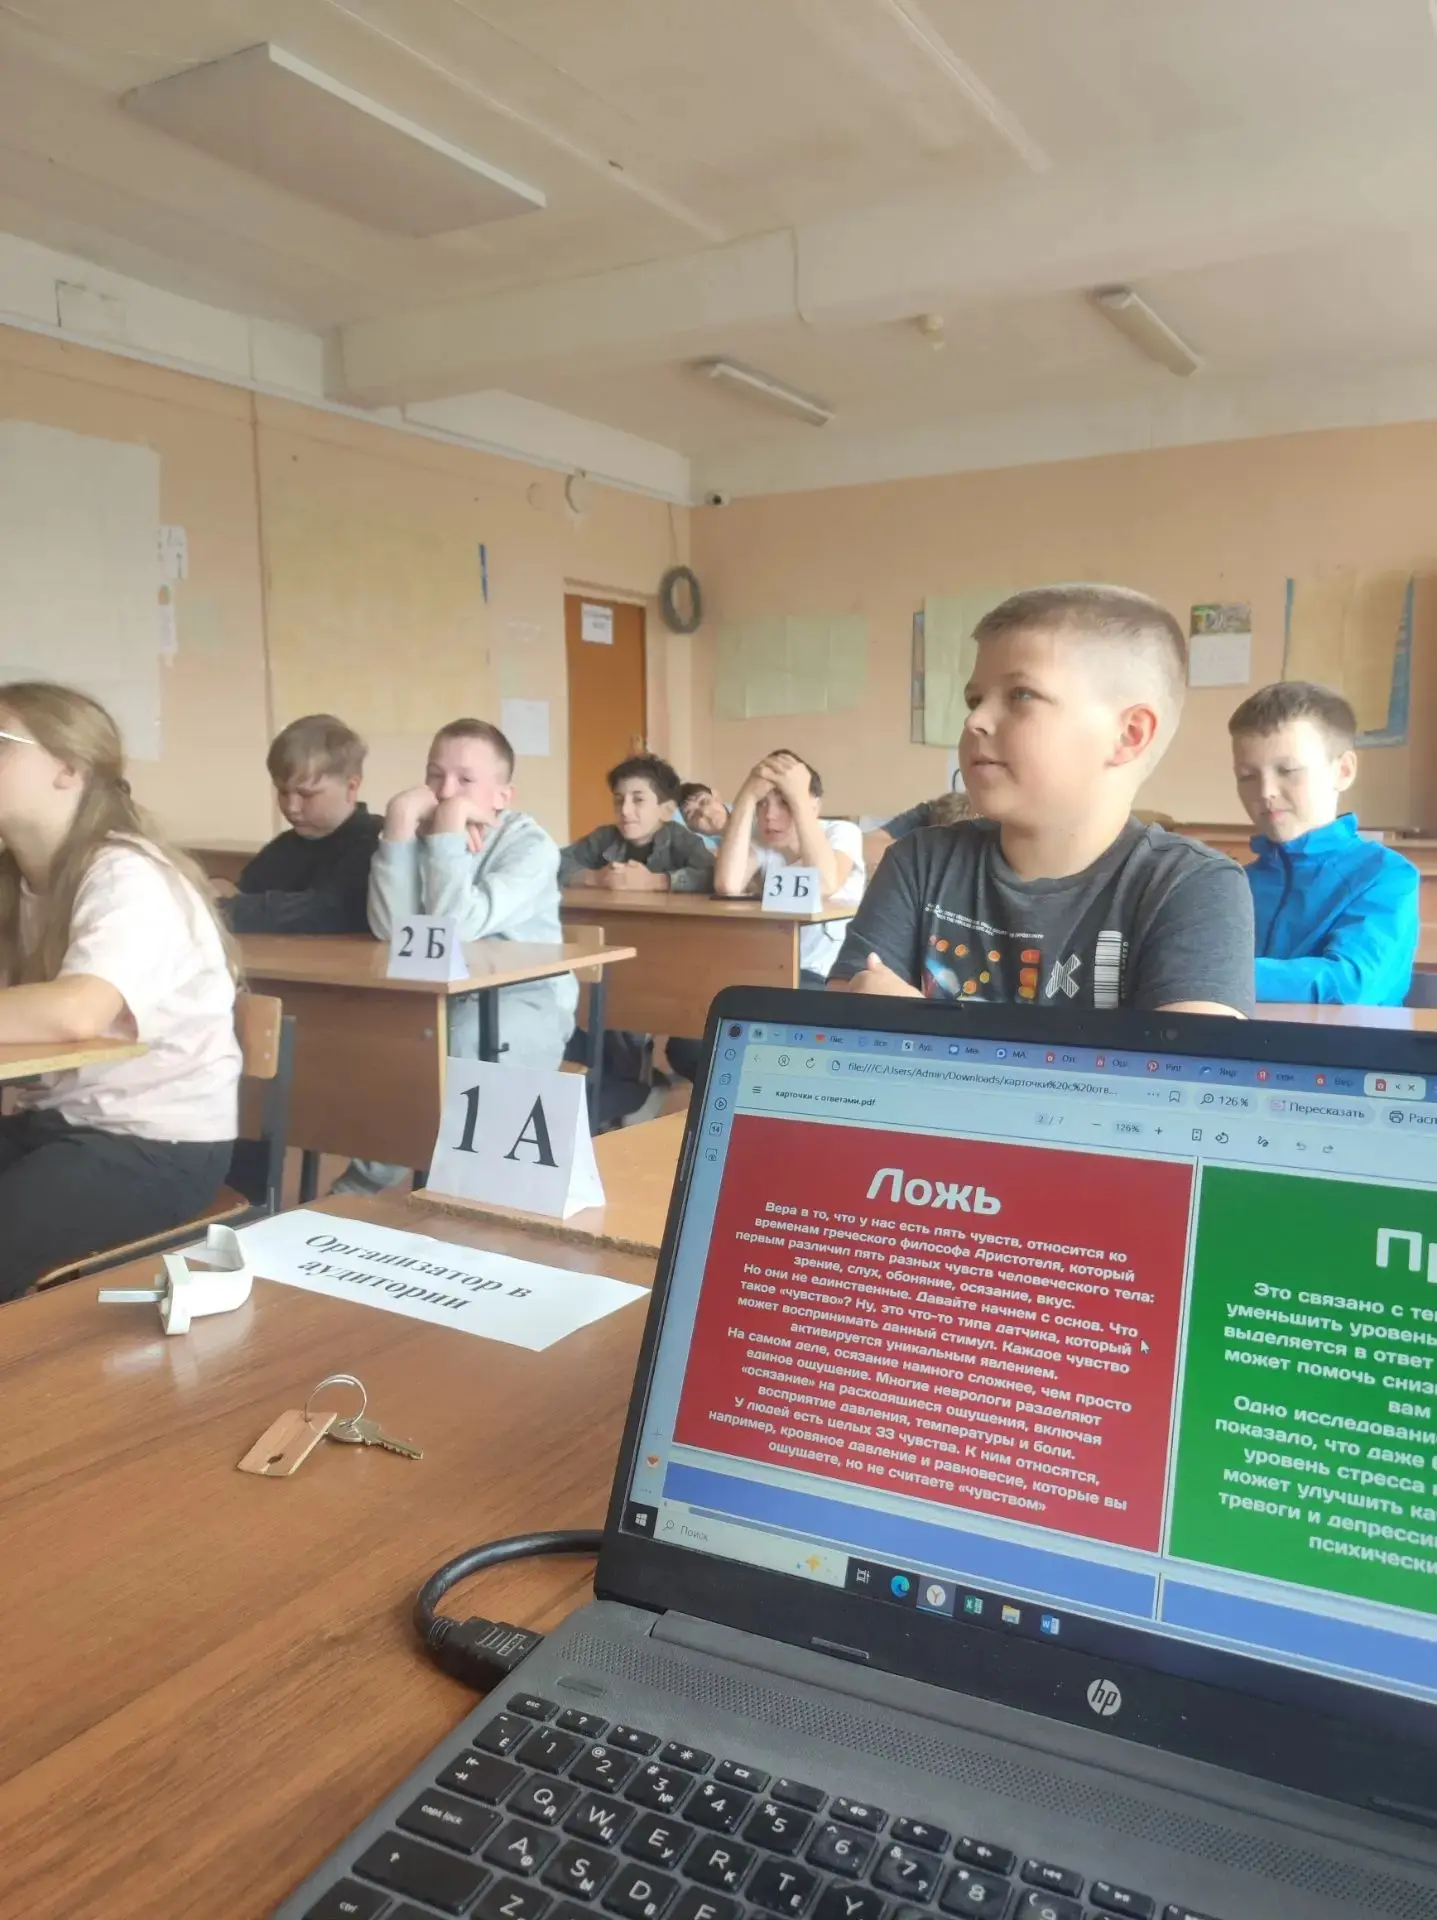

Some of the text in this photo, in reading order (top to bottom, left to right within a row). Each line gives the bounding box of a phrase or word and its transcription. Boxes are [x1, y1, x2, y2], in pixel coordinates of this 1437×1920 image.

[768, 875, 810, 898] 3 Б
[398, 926, 446, 959] 2 Б
[775, 1090, 813, 1100] карточки
[820, 1096, 876, 1107] ответами.pdf
[1290, 1102, 1365, 1118] Пересказать
[452, 1085, 560, 1168] 1 А
[1116, 1123, 1141, 1133] 126%
[866, 1167, 1002, 1215] Ложь
[754, 1217, 1136, 1283] временам греческого философа Аристотеля, который
[764, 1201, 1128, 1263] Вера в то, что у нас есть пять чувств, относится ко
[298, 1259, 472, 1310] аудитории
[305, 1234, 533, 1298] Организатор в
[735, 1231, 1156, 1305] первым различил пять разных чувств человеческого тела:
[793, 1256, 1076, 1310] зрение, слух, обоняние, осязание, вкус.
[740, 1280, 777, 1295] такое
[855, 1297, 877, 1313] Ну,
[880, 1304, 905, 1316] это
[907, 1308, 954, 1325] что-то
[957, 1316, 993, 1332] типа
[994, 1323, 1061, 1345] датчика,
[1064, 1335, 1133, 1356] который
[743, 1262, 1139, 1338] Но они не единственные. Давайте начнем с основ. Что
[1226, 1302, 1344, 1332] уменьшить
[1253, 1281, 1404, 1318] Это связано с
[737, 1296, 1132, 1375] может воспринимать данный стимул. Каждое чувство
[789, 1322, 1059, 1381] активируется уникальным явлением.
[1223, 1325, 1434, 1370] выделяется в ответ
[727, 1326, 1133, 1413] На самом деле, осязание намного сложнее, чем просто
[745, 1349, 794, 1366] единое
[875, 1371, 931, 1393] Многие
[933, 1384, 1013, 1409] неврологи
[1015, 1400, 1103, 1427] разделяют
[1224, 1348, 1377, 1386] может помочь
[757, 1385, 1076, 1460] восприятие давления, температуры и боли.
[818, 1380, 836, 1392] на
[1033, 1422, 1103, 1447] включая
[1233, 1395, 1288, 1419] Одно
[1387, 1400, 1431, 1419] вам
[708, 1410, 1128, 1512] например, кровяное давление и равновесие, которые вы
[734, 1395, 1101, 1487] У людей есть целых 33 чувства. К ним относятся,
[1215, 1418, 1318, 1451] показало,
[1324, 1438, 1361, 1456] что
[1366, 1446, 1425, 1469] даже
[845, 1458, 864, 1471] но
[866, 1463, 886, 1476] не
[887, 1467, 955, 1492] считаете
[1222, 1468, 1292, 1493] может
[1296, 1482, 1404, 1516] улучшить
[1243, 1447, 1331, 1476] уровень
[1336, 1465, 1426, 1494] стресса
[1218, 1491, 1322, 1525] тревоги и
[525, 1700, 540, 1708] esc
[1090, 1679, 1119, 1716] hp
[421, 1804, 463, 1825] caps lock
[533, 1788, 553, 1805] Q
[589, 1806, 615, 1825] W
[570, 1858, 591, 1877] S
[709, 1850, 730, 1869] R
